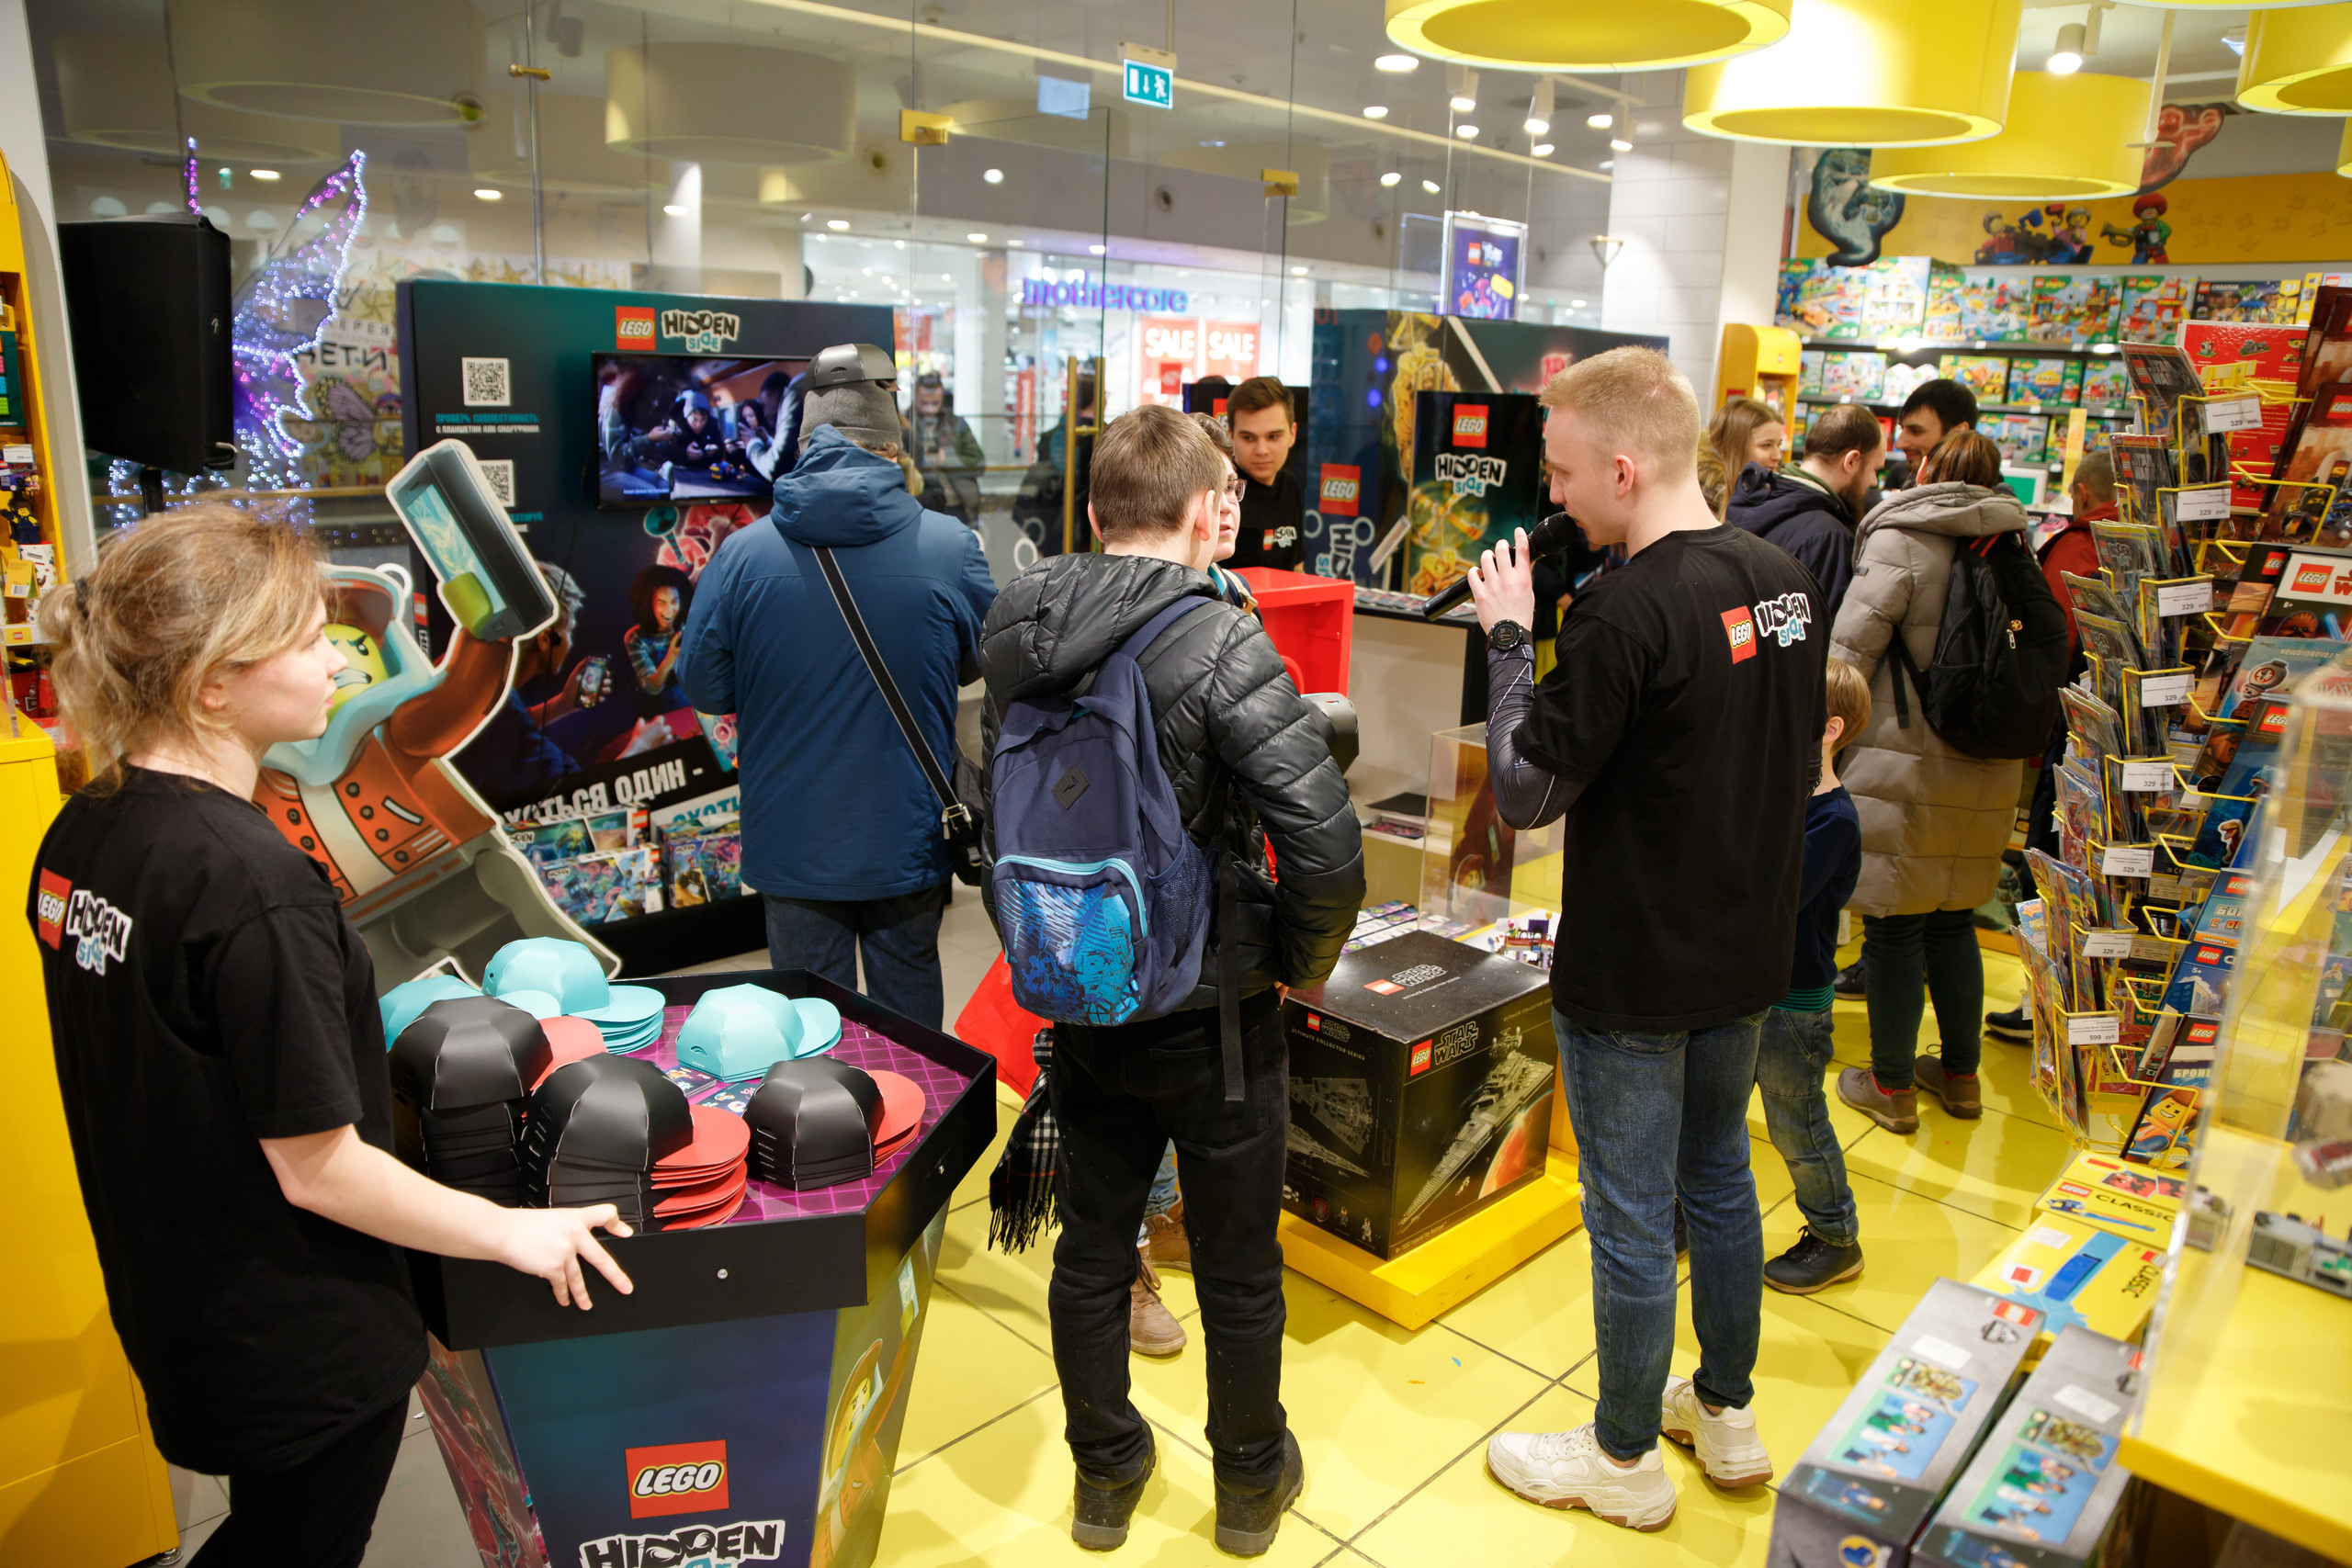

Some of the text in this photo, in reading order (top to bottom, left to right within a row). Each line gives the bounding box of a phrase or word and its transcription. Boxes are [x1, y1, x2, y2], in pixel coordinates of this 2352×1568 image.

[619, 311, 737, 338] LEGO HIDDEN
[688, 332, 719, 350] SIDE
[1145, 328, 1194, 358] SALE
[1208, 331, 1254, 360] SALE
[1455, 417, 1485, 434] LEGO
[1436, 456, 1503, 485] HIDDEN
[1322, 479, 1357, 500] LEGO
[1455, 478, 1484, 494] SIDE
[2298, 571, 2327, 585] LEGO
[1756, 595, 1811, 635] HIDDEN
[1731, 618, 1805, 647] LEGO SIDE
[615, 759, 686, 806] ОДИН
[38, 892, 129, 959] LEGO HIDDEN
[77, 938, 103, 971] SIDE
[2199, 952, 2219, 961] LEGO
[1393, 964, 1442, 980] STAR
[1393, 970, 1447, 987] WARS
[1307, 1017, 1348, 1033] LEGO STAR
[1322, 1026, 1351, 1043] WARS
[2191, 1029, 2215, 1038] LEGO
[1291, 1028, 1365, 1061] ULTIMATE COLLECTOR SERIES
[1412, 1021, 1478, 1066] LEGO STAR
[1434, 1034, 1478, 1065] WARS
[2096, 1194, 2176, 1223] CLASSIC
[636, 1462, 720, 1496] LEGO
[582, 1522, 778, 1568] HIDDEN
